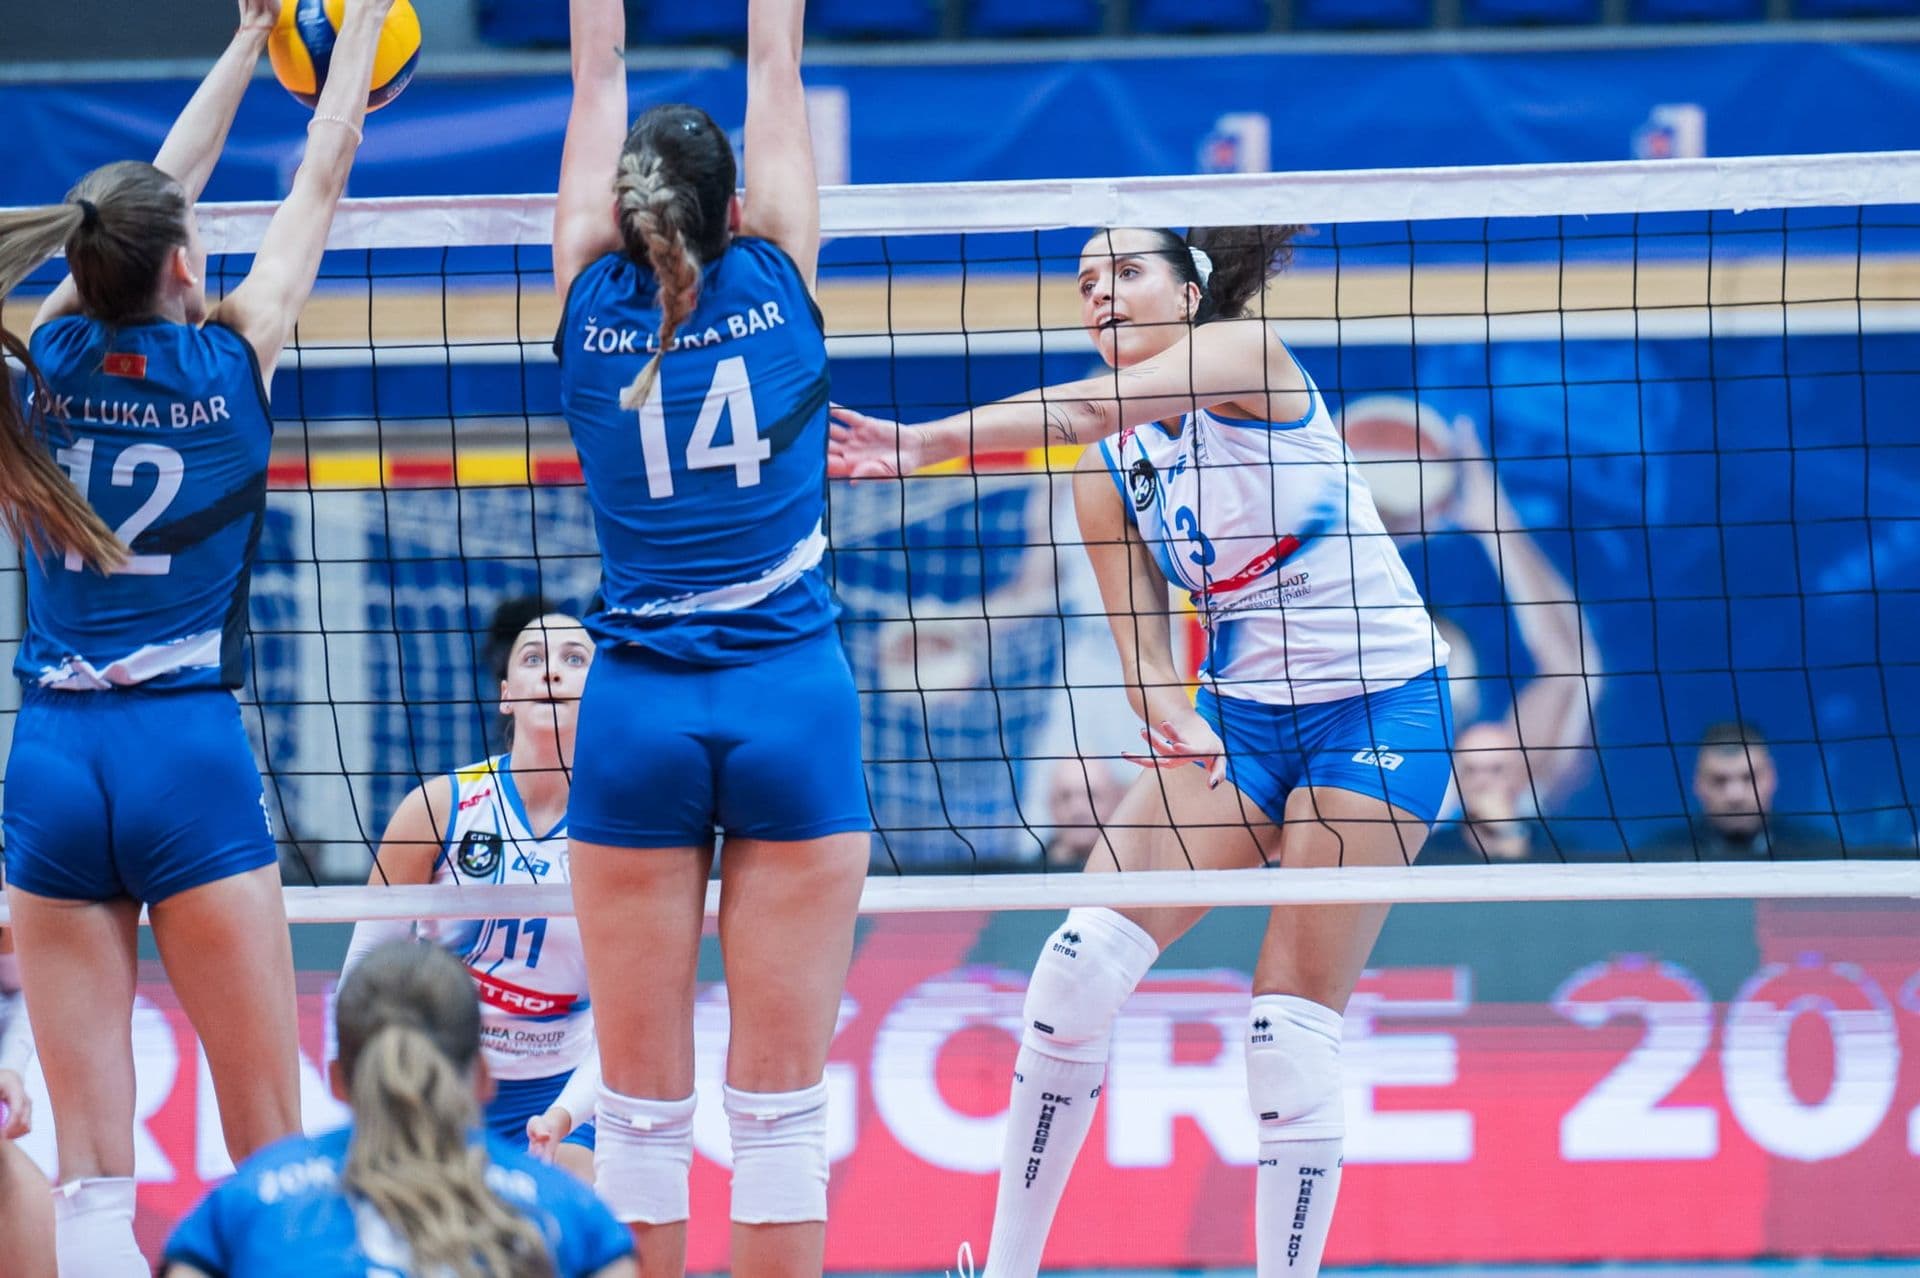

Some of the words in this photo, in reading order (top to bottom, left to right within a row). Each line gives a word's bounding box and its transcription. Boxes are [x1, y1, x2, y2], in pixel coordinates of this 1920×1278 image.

[583, 316, 637, 353] ŽOK
[727, 301, 785, 340] BAR
[84, 397, 160, 429] LUKA
[170, 394, 231, 429] BAR
[619, 355, 771, 499] 14
[57, 438, 184, 576] 12
[1175, 505, 1216, 566] 3
[497, 918, 548, 969] 11
[1553, 951, 1920, 1162] 20
[1025, 1157, 1041, 1189] NOVI
[1287, 1234, 1302, 1267] NOVI
